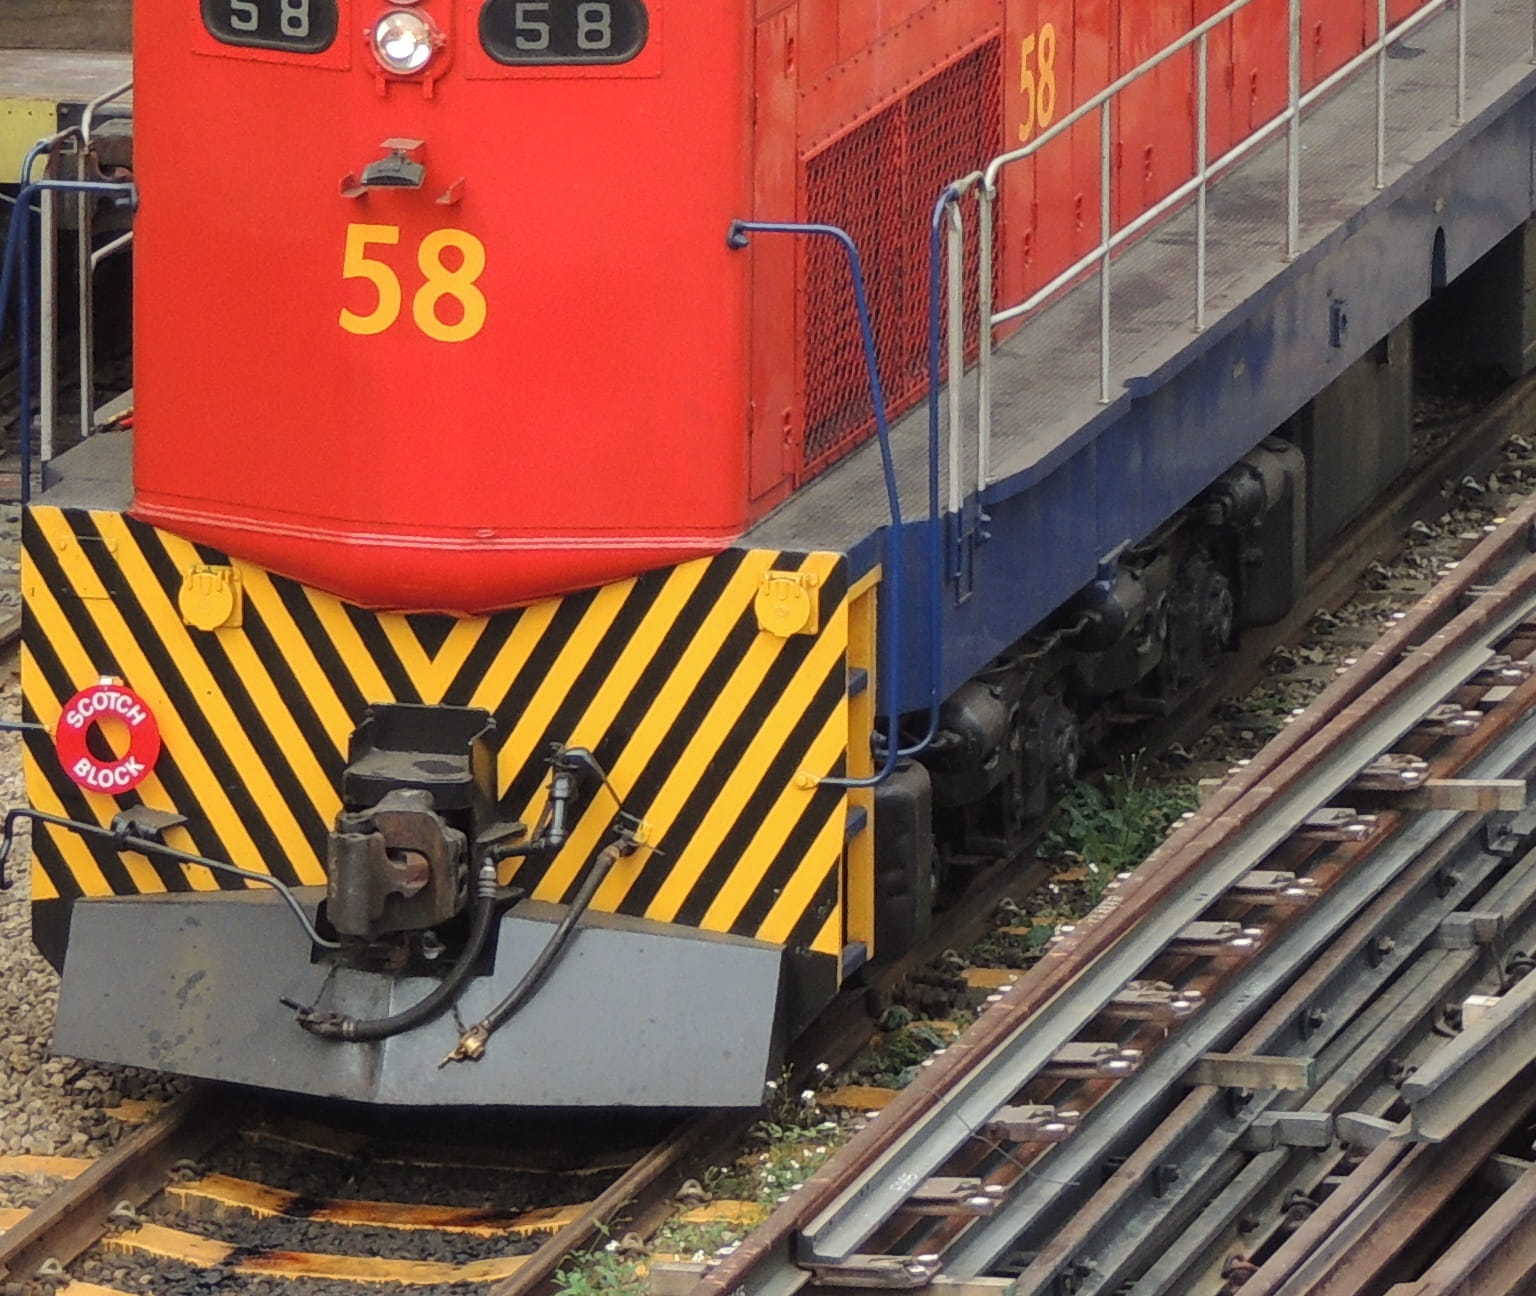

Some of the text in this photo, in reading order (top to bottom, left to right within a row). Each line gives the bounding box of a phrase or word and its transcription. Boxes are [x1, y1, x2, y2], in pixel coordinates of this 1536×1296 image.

[515, 2, 611, 50] 58
[1018, 22, 1056, 142] 58
[338, 222, 487, 343] 58
[66, 691, 147, 729] SCOTCH
[73, 755, 145, 788] BLOCK
